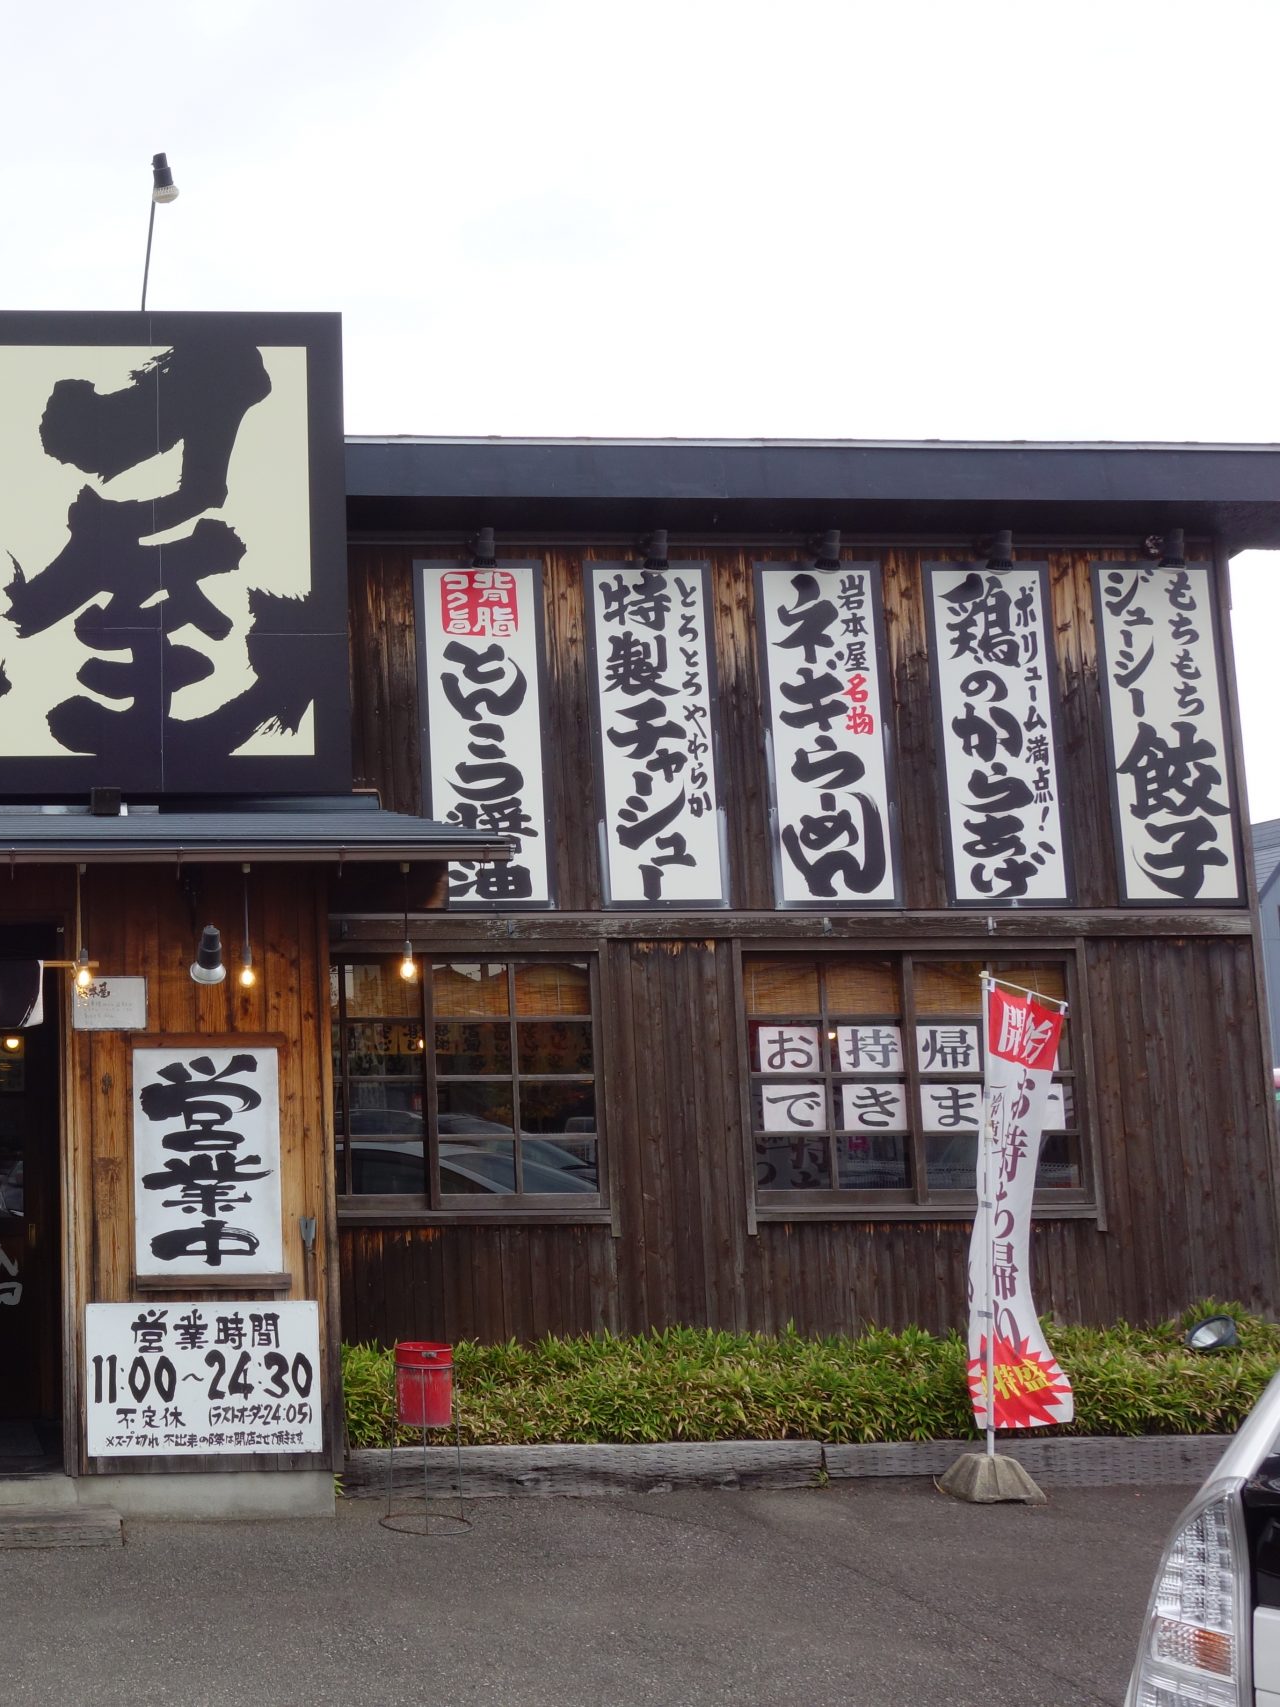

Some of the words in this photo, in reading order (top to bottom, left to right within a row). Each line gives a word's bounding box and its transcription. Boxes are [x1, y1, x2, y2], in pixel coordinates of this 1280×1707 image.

[472, 571, 518, 637] 背脂
[1103, 569, 1155, 718] ジューシー
[1164, 572, 1205, 717] もちもち
[598, 571, 697, 900] 特製チャーシュー
[771, 573, 886, 898] ネギらーめん
[937, 572, 1056, 898] 鶏のからあげ
[1115, 721, 1232, 899] 餃子
[77, 981, 111, 998] 本屋
[996, 1000, 1054, 1065] 開始
[767, 1028, 976, 1070] お持帰
[766, 1086, 1060, 1128] できま
[138, 1053, 275, 1268] 営業中
[130, 1308, 281, 1354] 営業時間
[115, 1405, 187, 1430] 不定休
